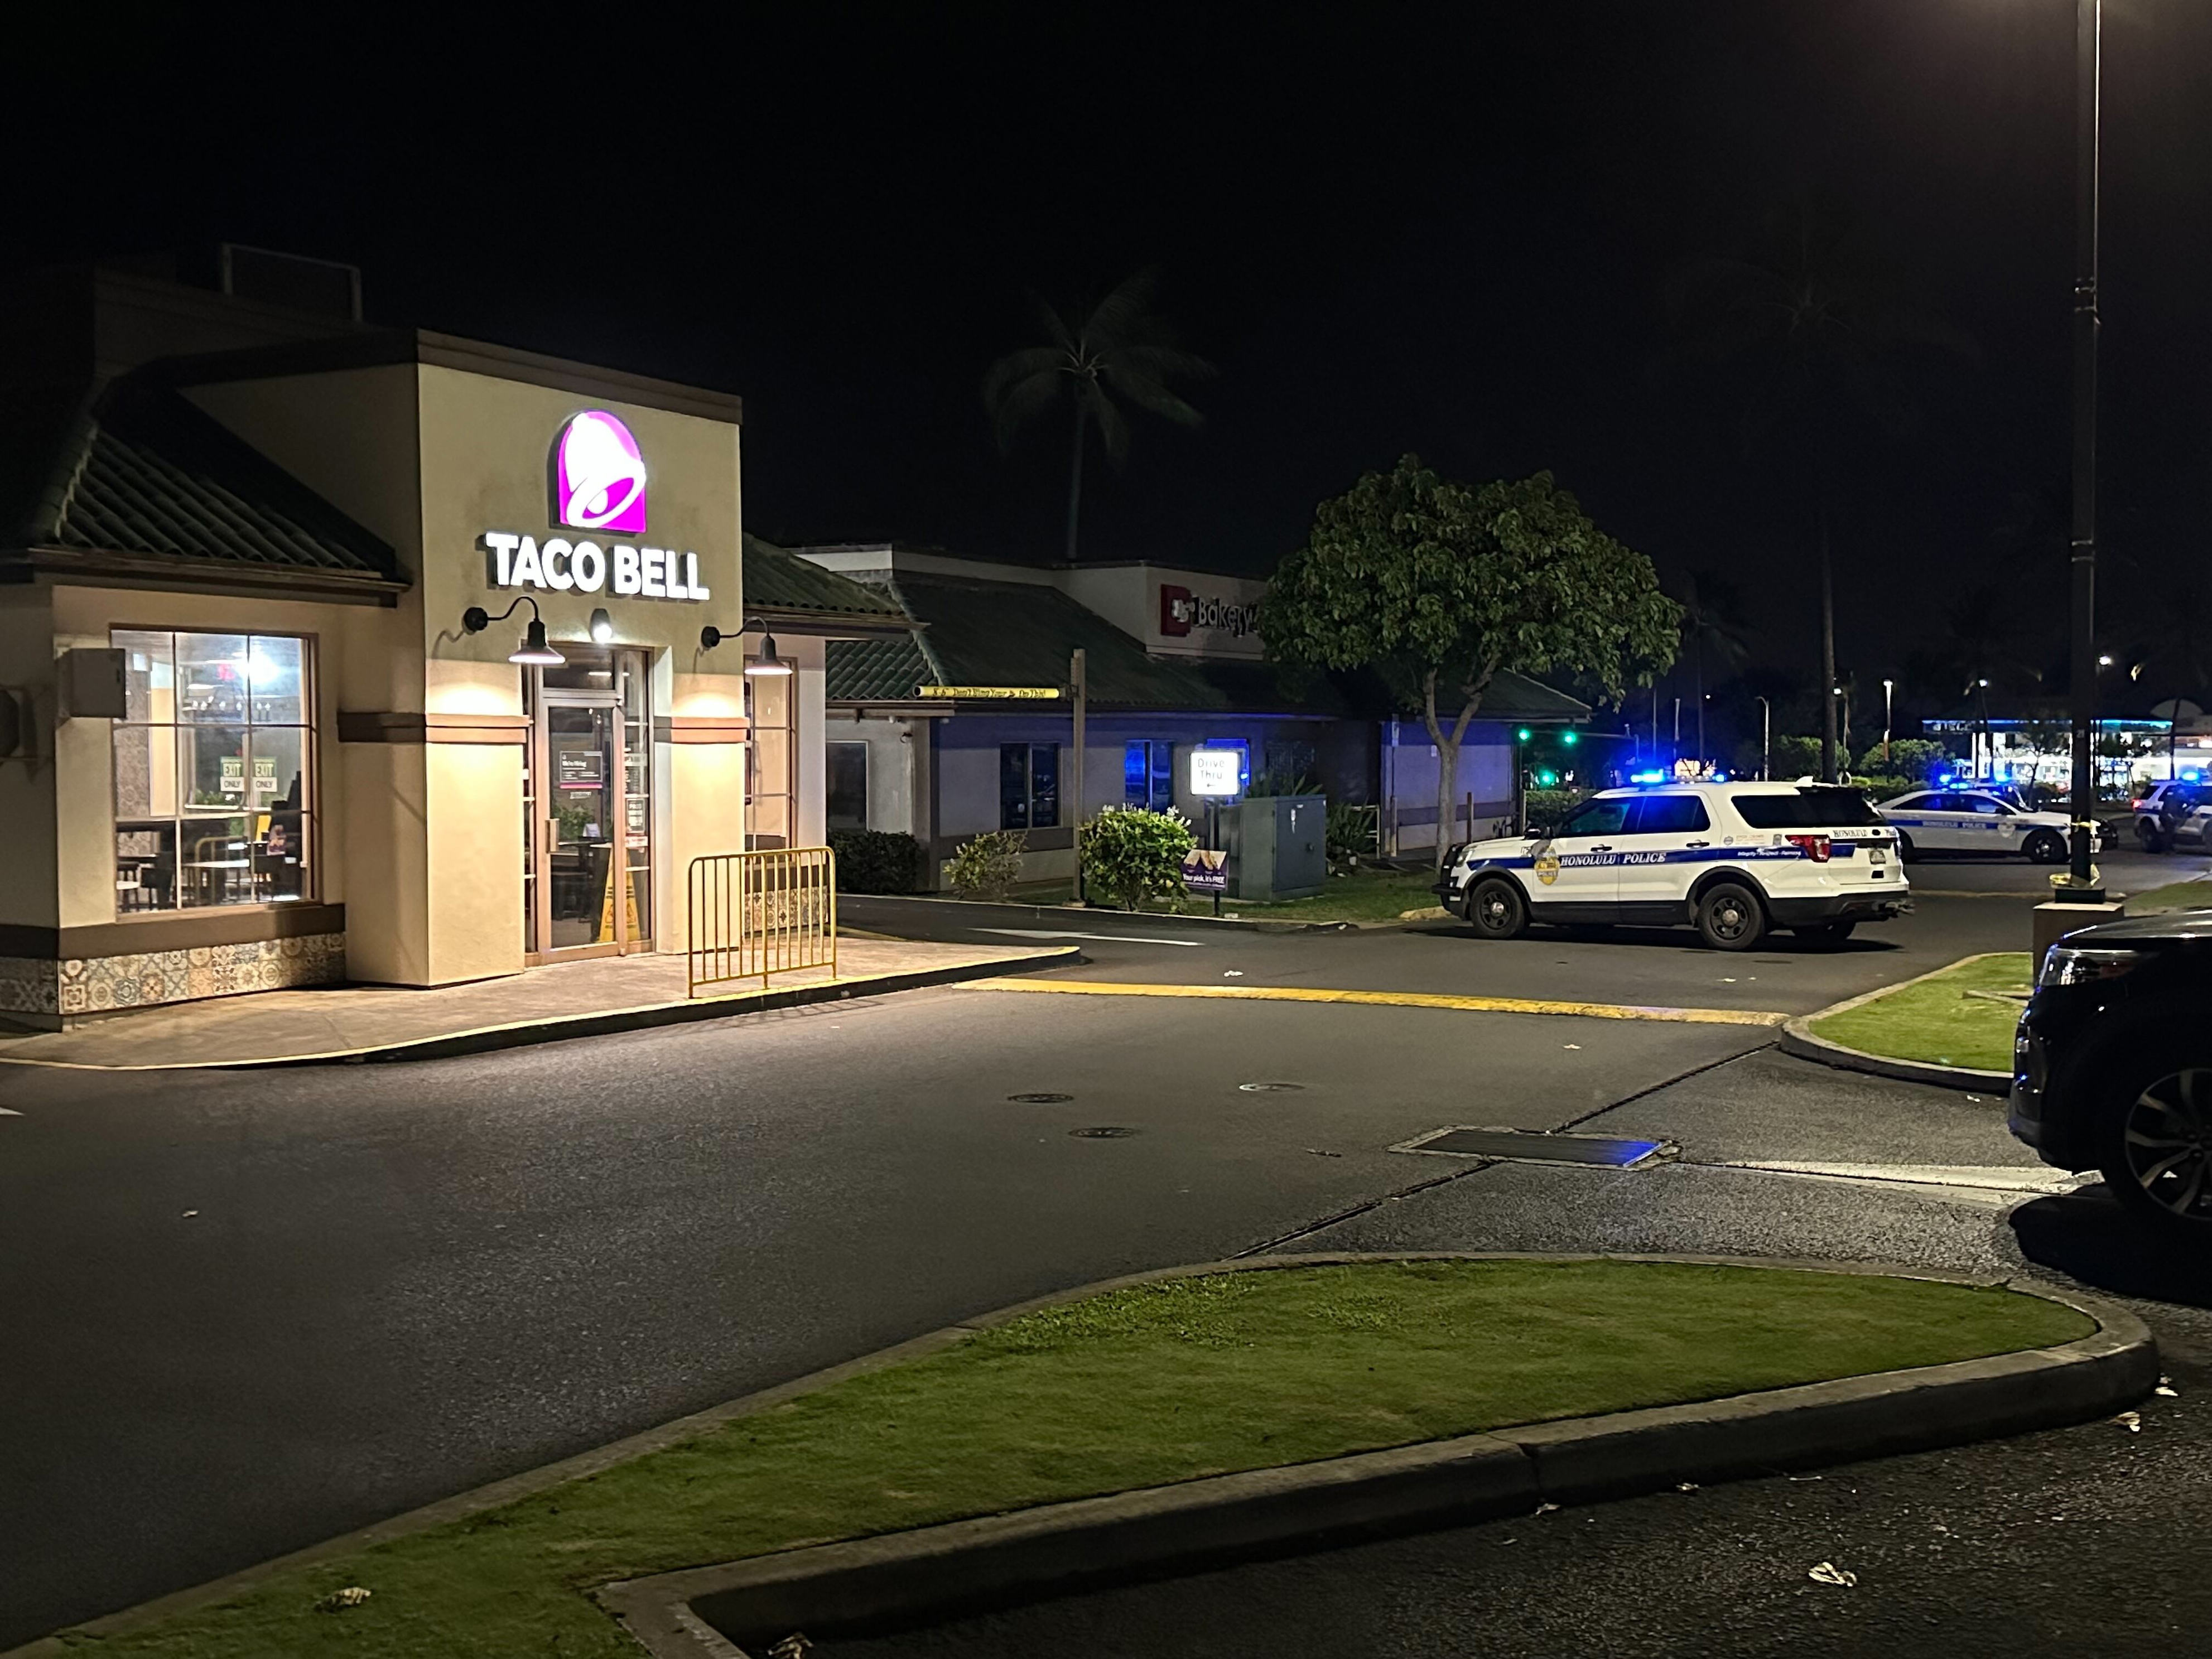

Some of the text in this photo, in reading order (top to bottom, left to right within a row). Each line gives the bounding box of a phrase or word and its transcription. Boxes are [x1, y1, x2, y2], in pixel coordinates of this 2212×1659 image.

[485, 532, 710, 601] TACO BELL
[1198, 596, 1253, 634] Bakery
[223, 763, 241, 777] EXIT
[255, 763, 273, 777] EXIT
[1198, 758, 1225, 768] Drive
[1201, 770, 1222, 779] Thru
[1562, 852, 1666, 866] HONOLULU POLICE
